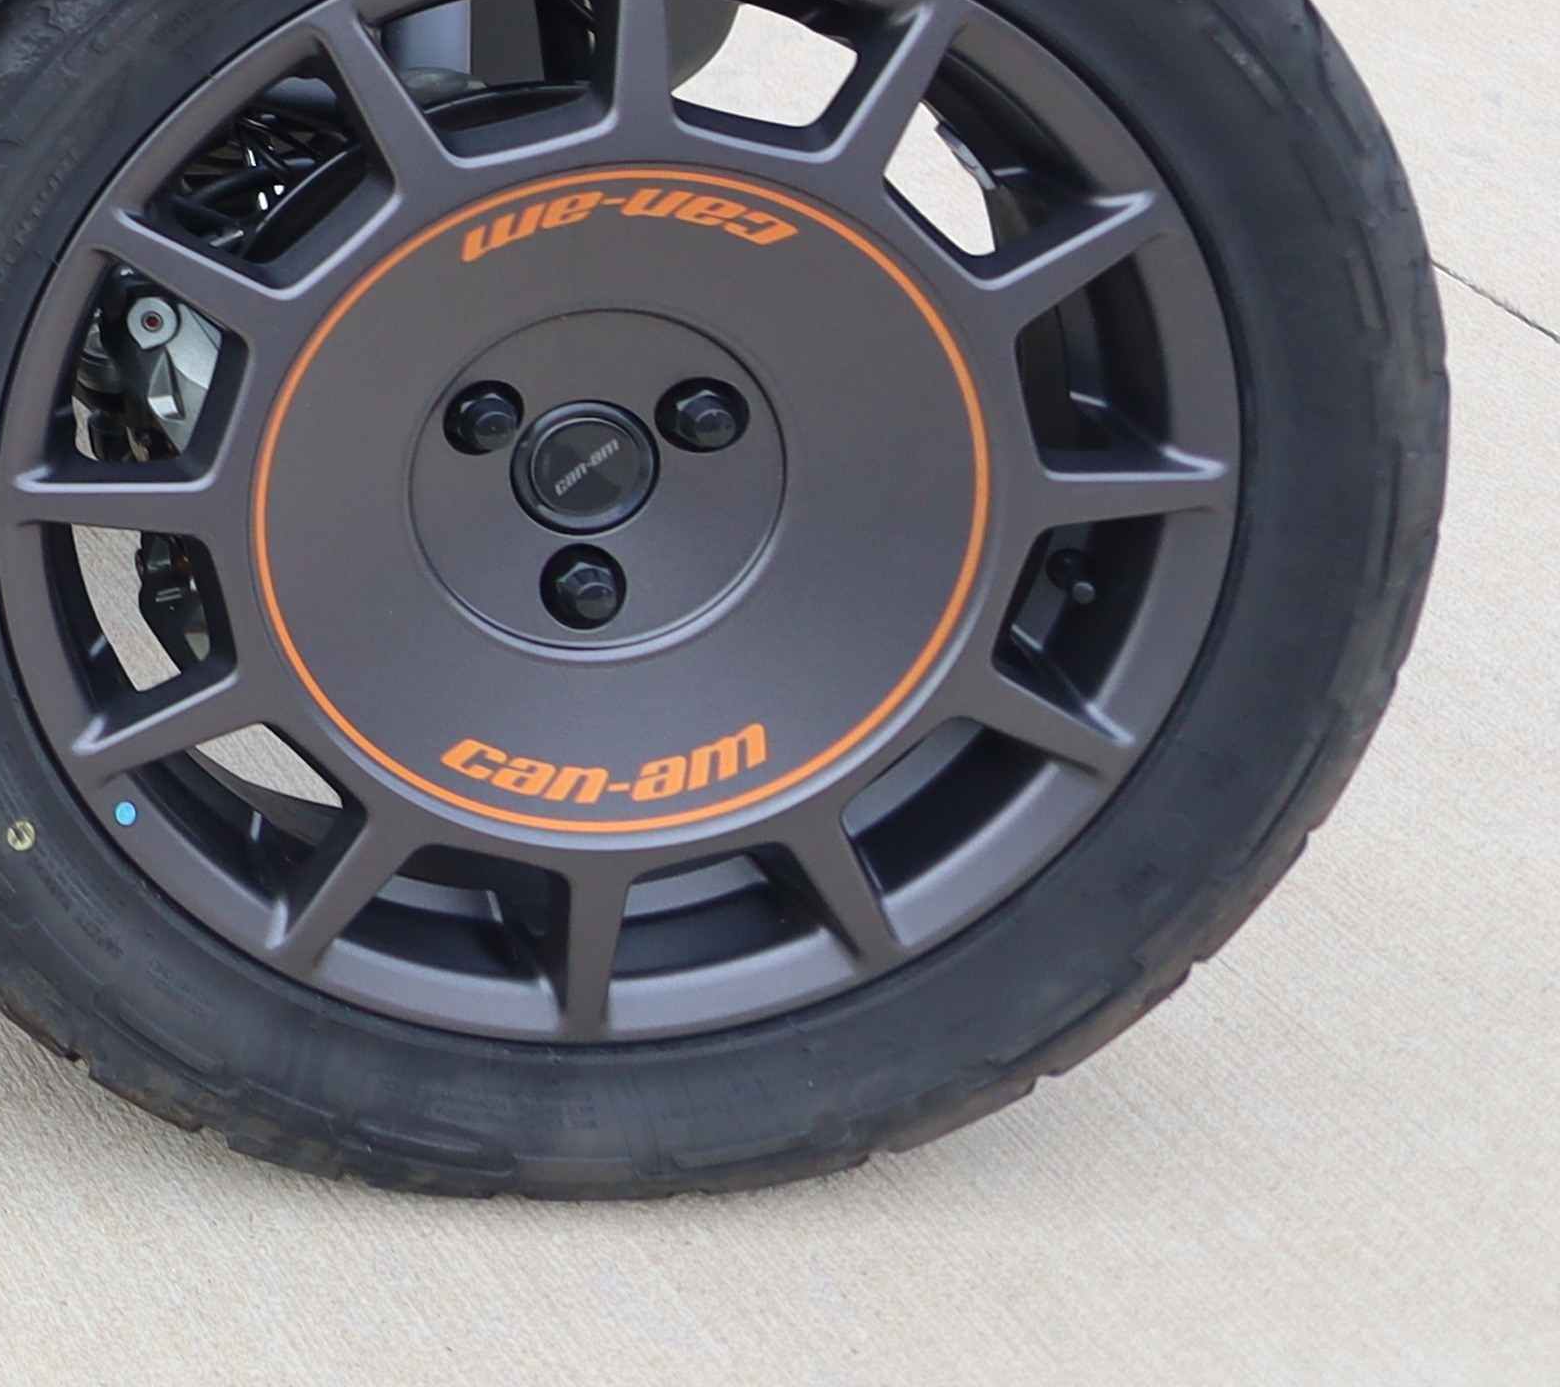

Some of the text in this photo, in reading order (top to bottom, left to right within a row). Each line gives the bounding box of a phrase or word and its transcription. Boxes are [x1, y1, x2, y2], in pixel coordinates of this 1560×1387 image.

[460, 187, 799, 263] can-am
[554, 439, 620, 496] can-am
[439, 722, 767, 804] can-am
